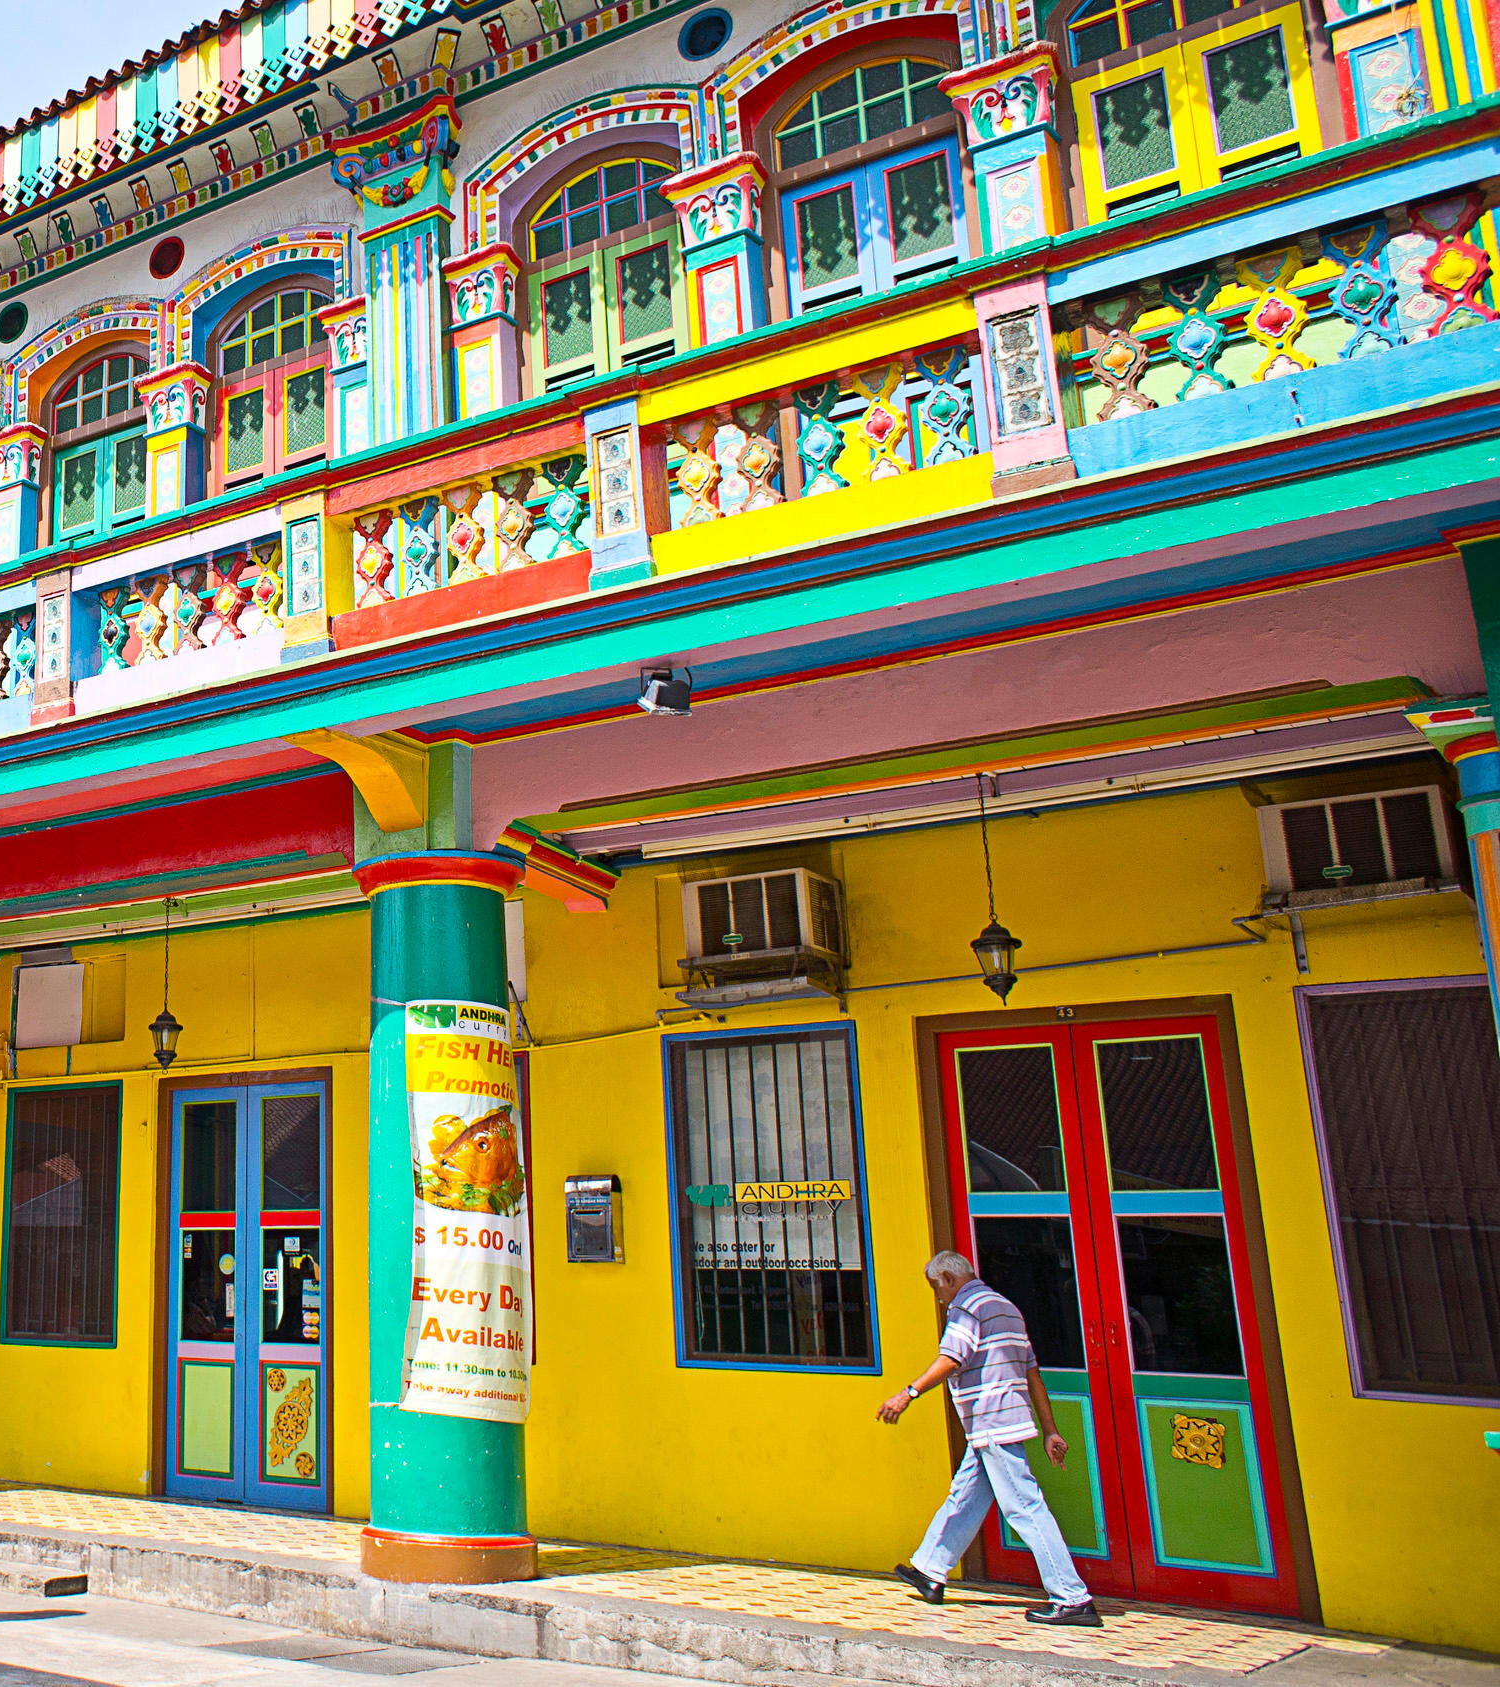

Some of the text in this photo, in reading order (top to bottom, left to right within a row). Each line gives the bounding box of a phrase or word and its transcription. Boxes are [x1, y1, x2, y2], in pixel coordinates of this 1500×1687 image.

[459, 1008, 507, 1026] ANDHRA
[458, 1020, 507, 1039] curry
[487, 1040, 512, 1069] HE
[741, 1183, 845, 1200] ANDHRA
[741, 1200, 843, 1216] curry
[436, 1225, 504, 1251] 15.00
[507, 1239, 523, 1258] Onl
[411, 1276, 524, 1318] Every Day
[420, 1317, 524, 1352] Available
[445, 1362, 494, 1377] 11.30am
[497, 1368, 506, 1378] to
[437, 1385, 471, 1399] away
[473, 1389, 518, 1402] additional
